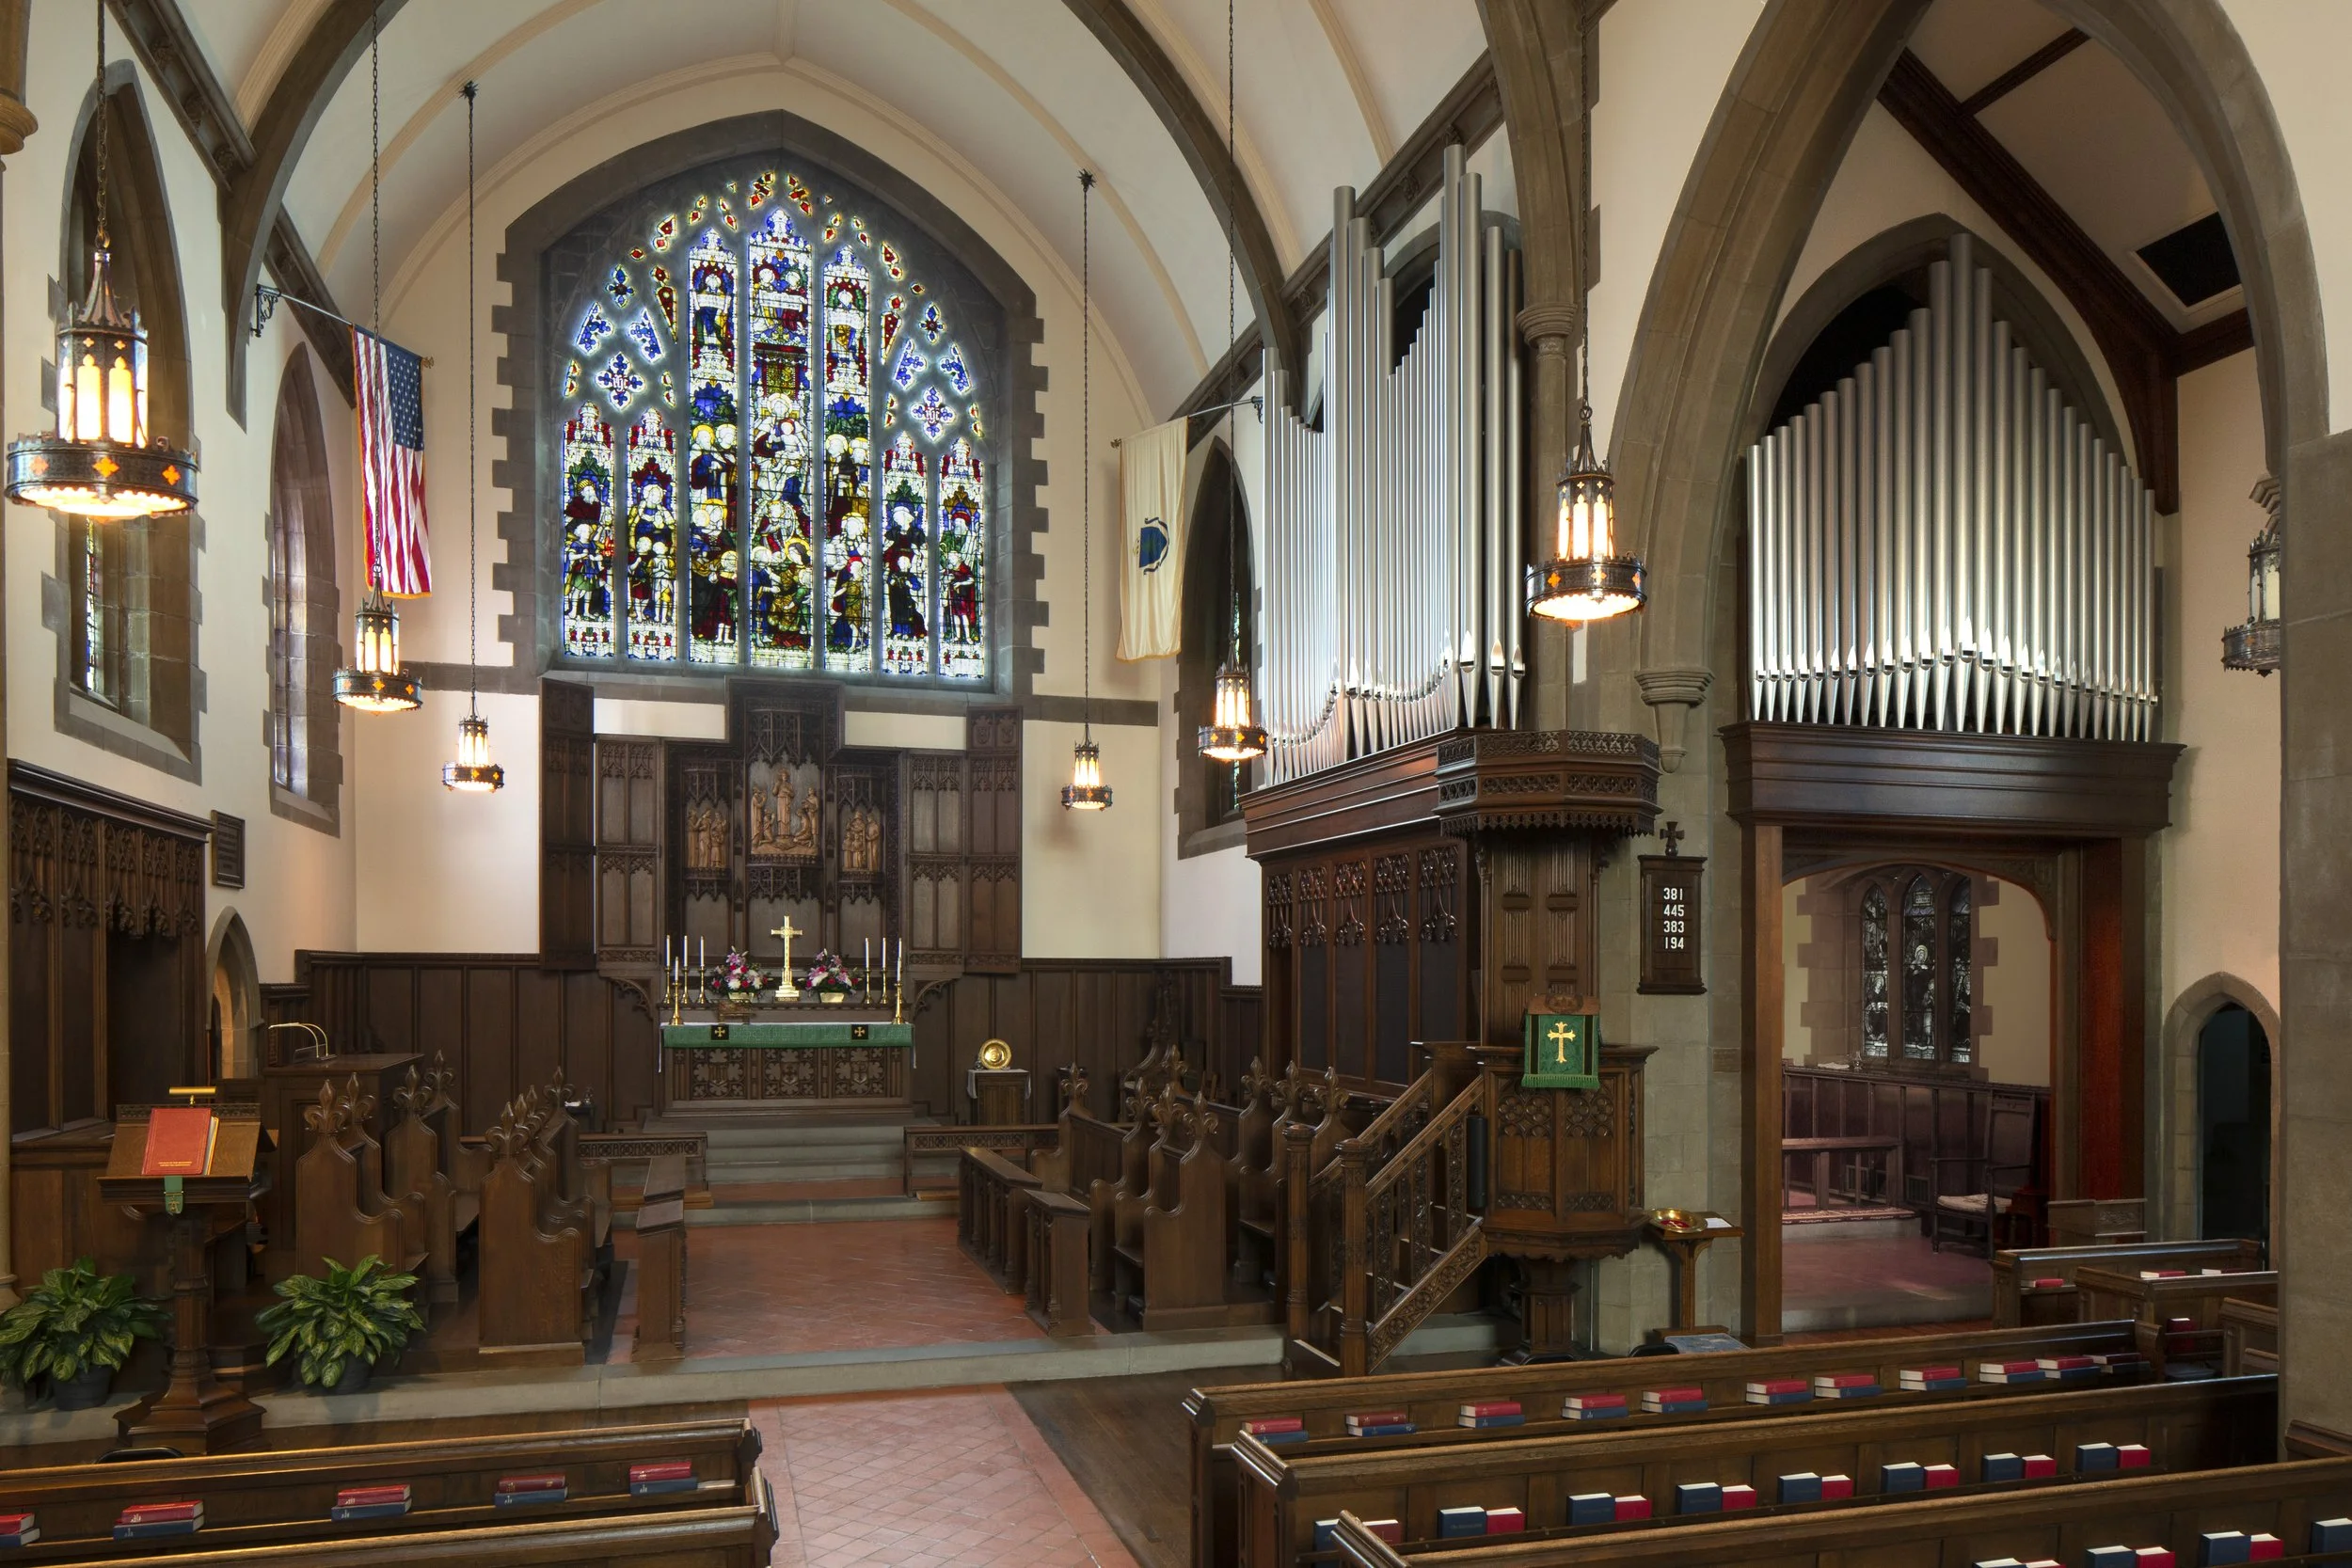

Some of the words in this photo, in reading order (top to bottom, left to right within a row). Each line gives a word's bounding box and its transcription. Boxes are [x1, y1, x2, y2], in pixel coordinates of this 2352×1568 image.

[1663, 887, 1683, 900] 381
[1663, 904, 1684, 917] 445
[1663, 920, 1684, 933] 383
[1665, 936, 1684, 949] 194
